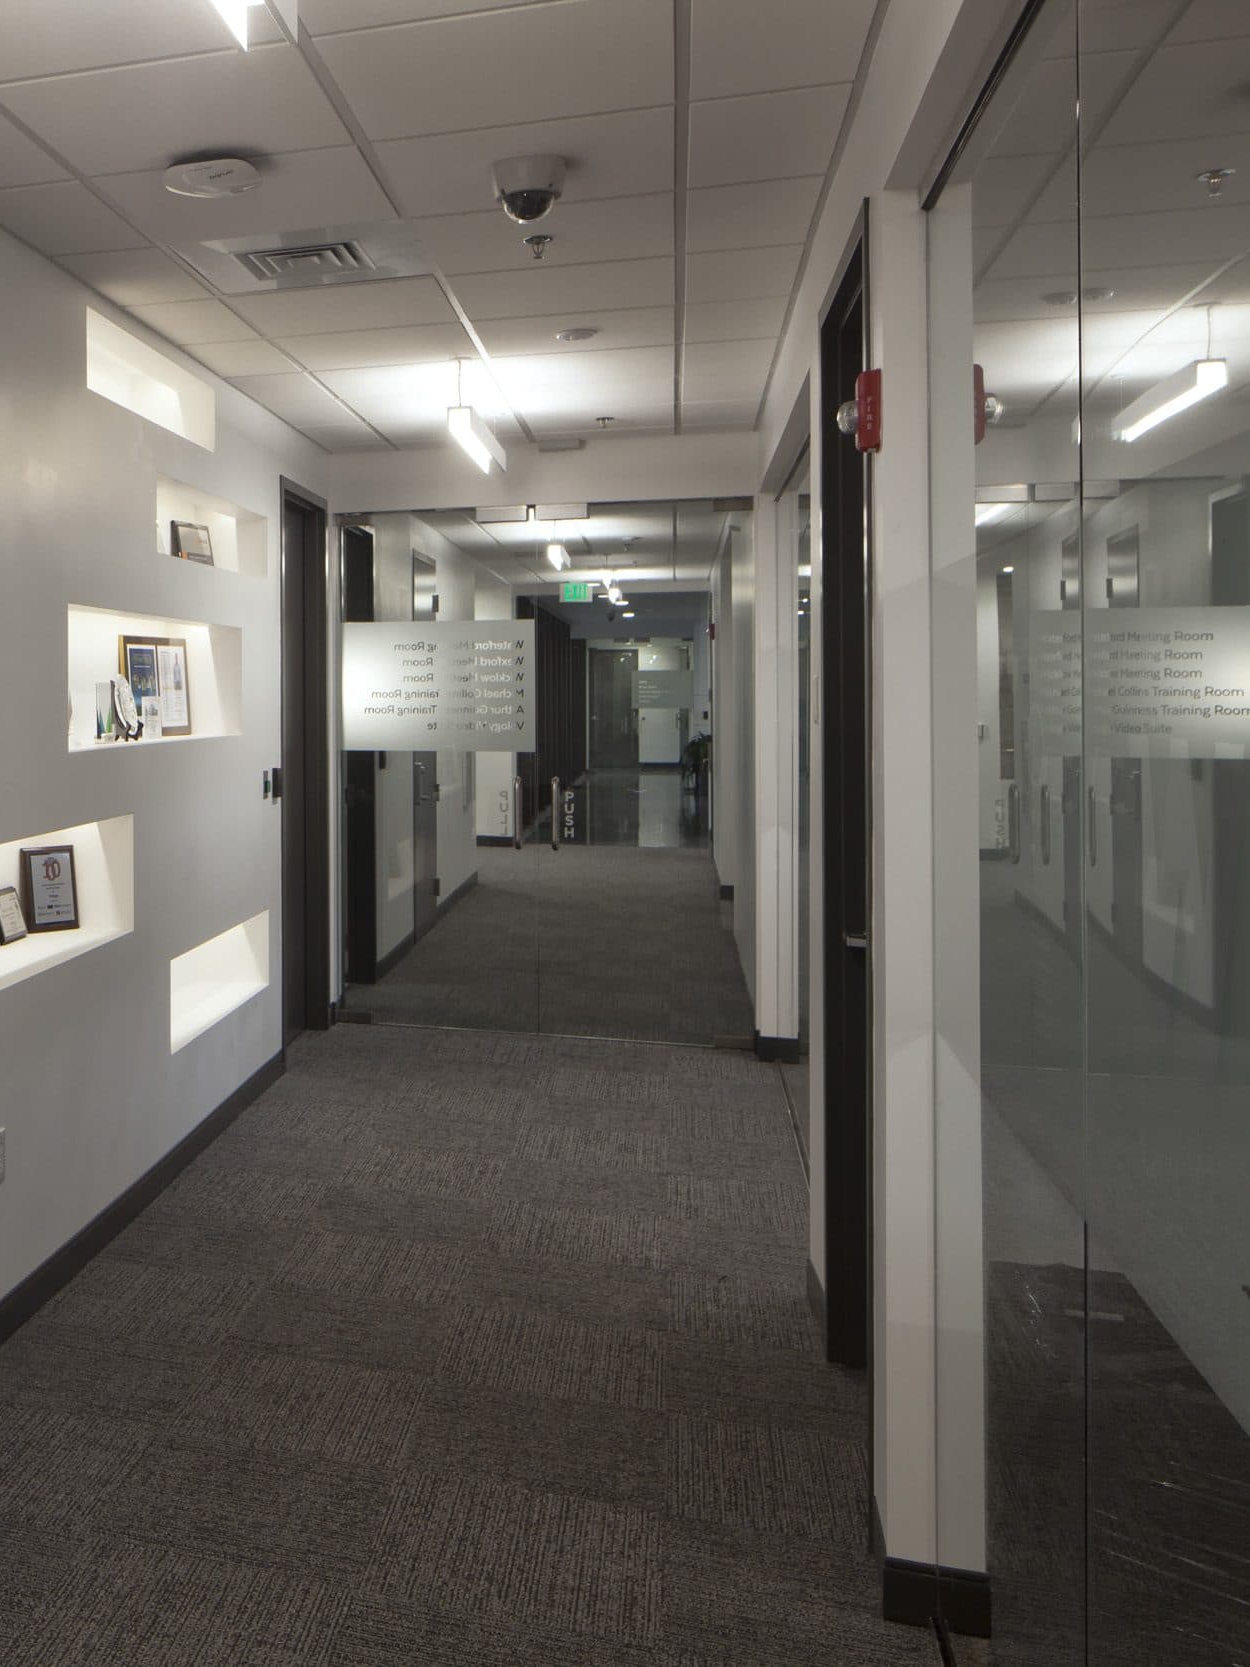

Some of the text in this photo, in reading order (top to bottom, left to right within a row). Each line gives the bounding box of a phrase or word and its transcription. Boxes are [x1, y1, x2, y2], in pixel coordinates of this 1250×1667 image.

[1174, 631, 1214, 641] Room
[1164, 649, 1203, 660] Room
[1164, 668, 1202, 678] Room
[1152, 686, 1201, 699] Training
[1204, 686, 1245, 697] Room
[1161, 705, 1211, 718] Training
[564, 791, 574, 838] PUSH
